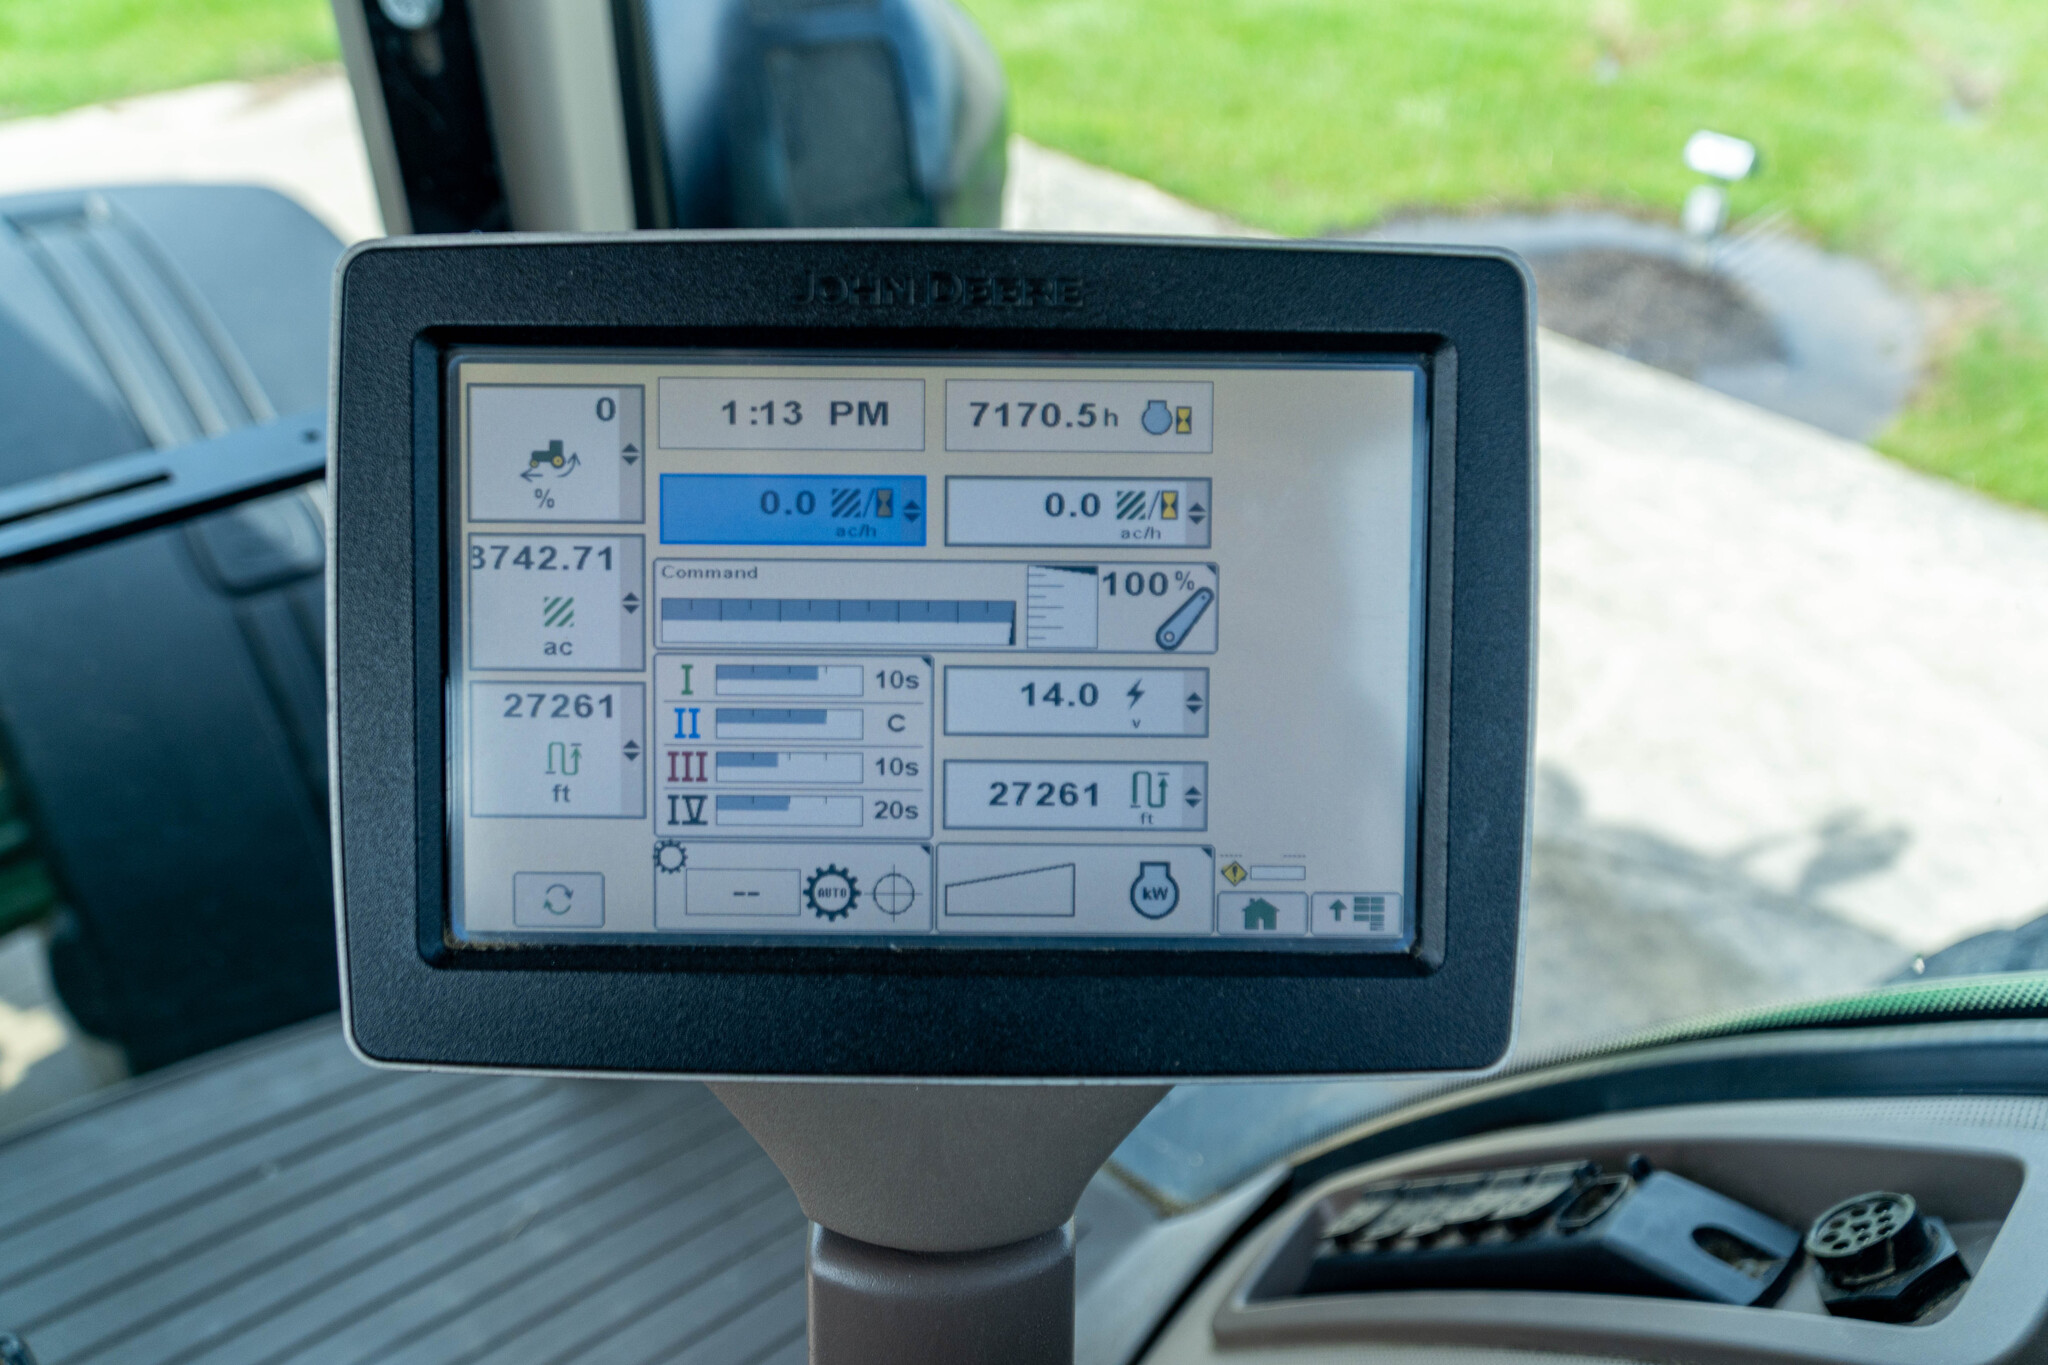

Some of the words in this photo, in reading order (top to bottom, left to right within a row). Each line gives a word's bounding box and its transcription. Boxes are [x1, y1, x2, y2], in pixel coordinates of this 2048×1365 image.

[797, 268, 915, 306] JOHN
[926, 268, 1083, 306] DEERE
[596, 397, 616, 421] 0
[721, 400, 803, 426] 1:13
[829, 400, 889, 426] PM
[760, 490, 815, 515] 0.0
[1045, 493, 1100, 518] 0.0
[835, 524, 877, 539] ac/h
[1121, 527, 1161, 541] ac/h
[661, 565, 758, 580] Command
[543, 641, 573, 656] ac
[875, 670, 919, 690] 10s
[1021, 682, 1100, 707] 14.0
[503, 693, 613, 719] 27261
[887, 714, 906, 732] C
[875, 757, 919, 777] 10s
[552, 784, 571, 803] ft
[988, 782, 1100, 807] 27261
[875, 801, 919, 820] 20s
[1141, 812, 1154, 826] ft
[816, 886, 848, 899] AUTO
[1142, 886, 1169, 901] kW
